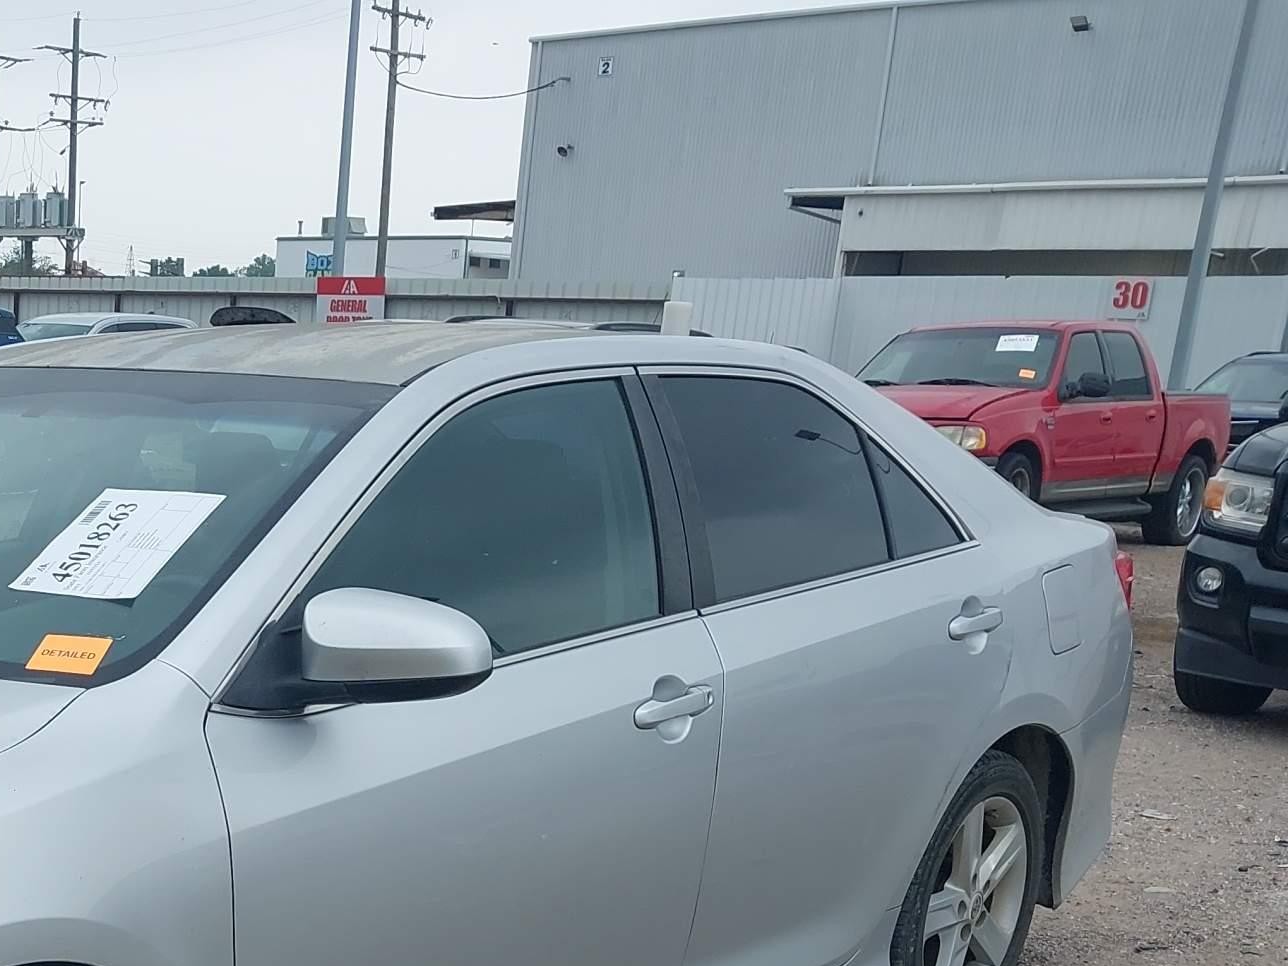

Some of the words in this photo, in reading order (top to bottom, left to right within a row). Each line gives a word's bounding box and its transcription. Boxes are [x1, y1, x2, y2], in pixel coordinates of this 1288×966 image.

[601, 62, 610, 74] 2
[1113, 281, 1148, 309] 30
[329, 299, 368, 313] GENERAL
[52, 503, 138, 583] 45018263
[41, 648, 96, 660] DETAILED
